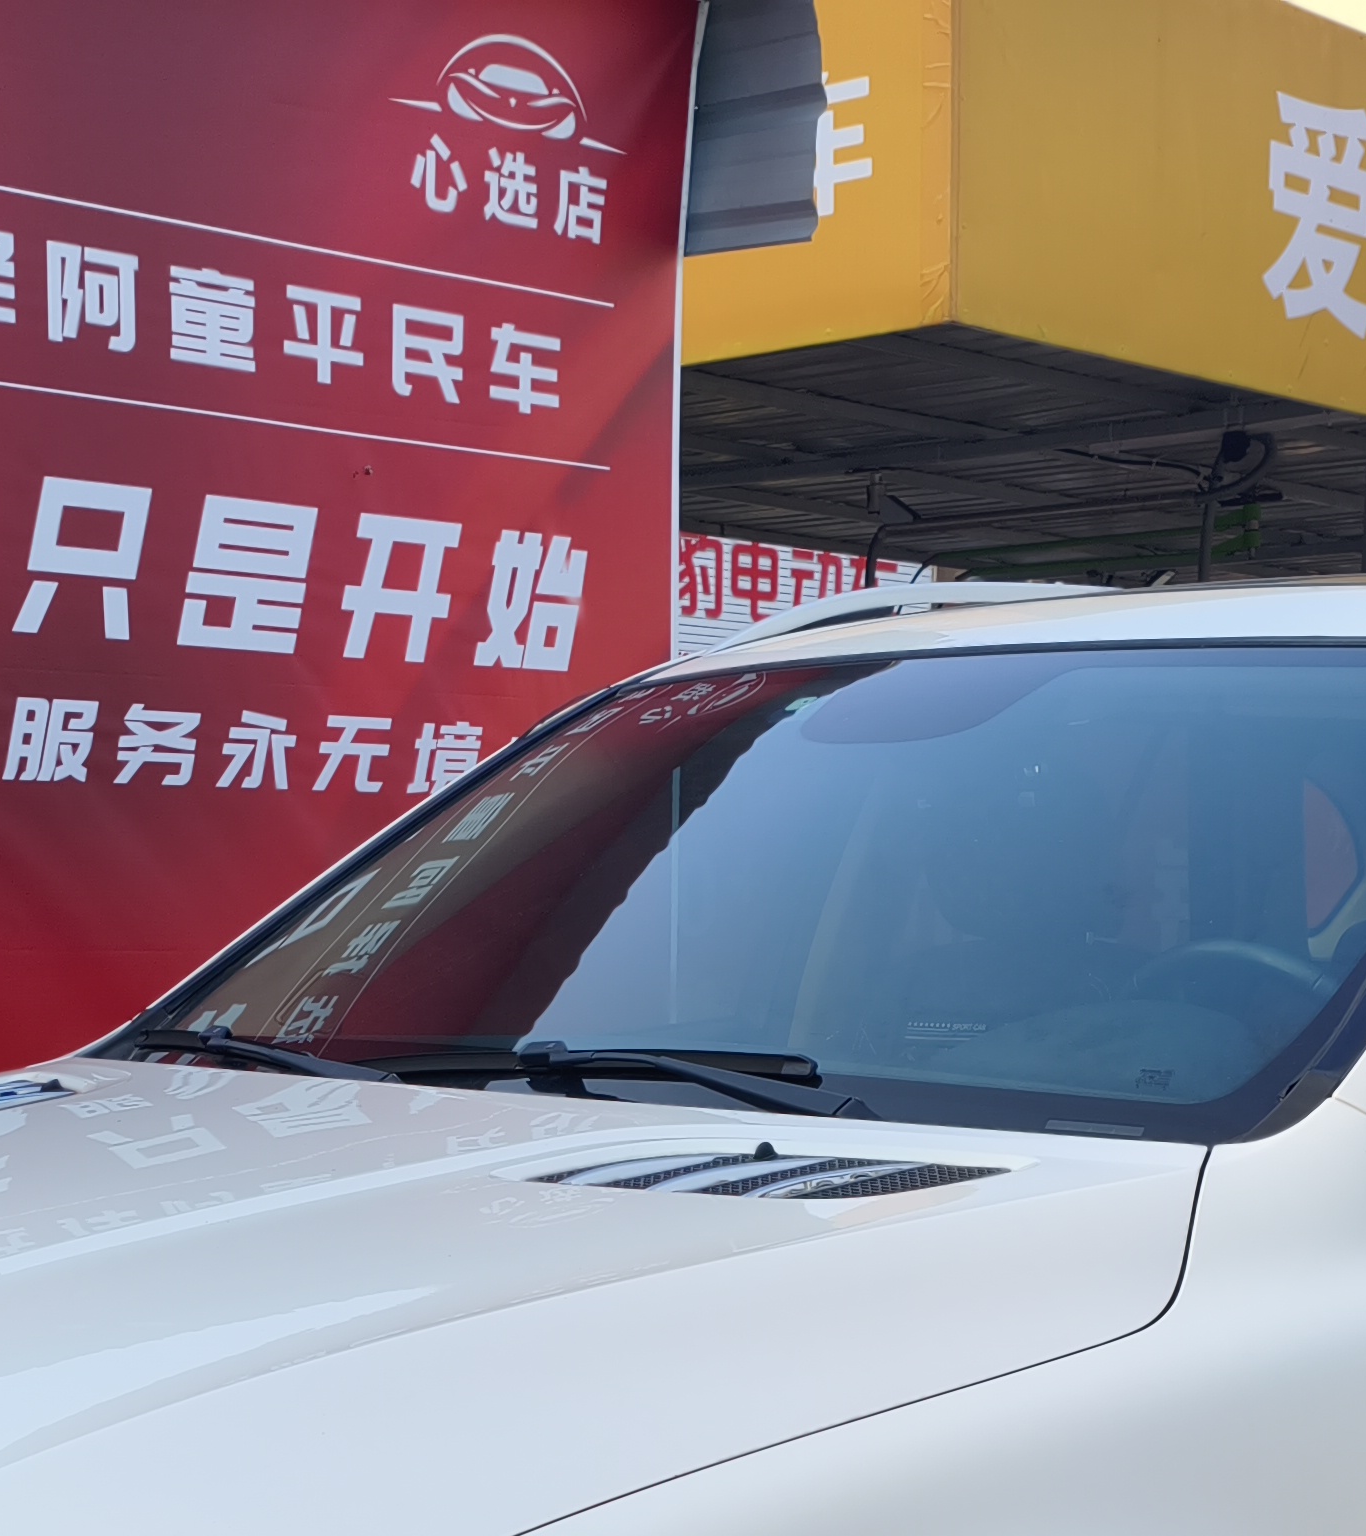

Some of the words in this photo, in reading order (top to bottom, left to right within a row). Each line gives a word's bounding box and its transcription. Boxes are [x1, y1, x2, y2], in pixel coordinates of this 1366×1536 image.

[410, 133, 609, 245] 心选店
[12, 475, 589, 672] 只是开始
[1, 696, 521, 795] 服务永无境
